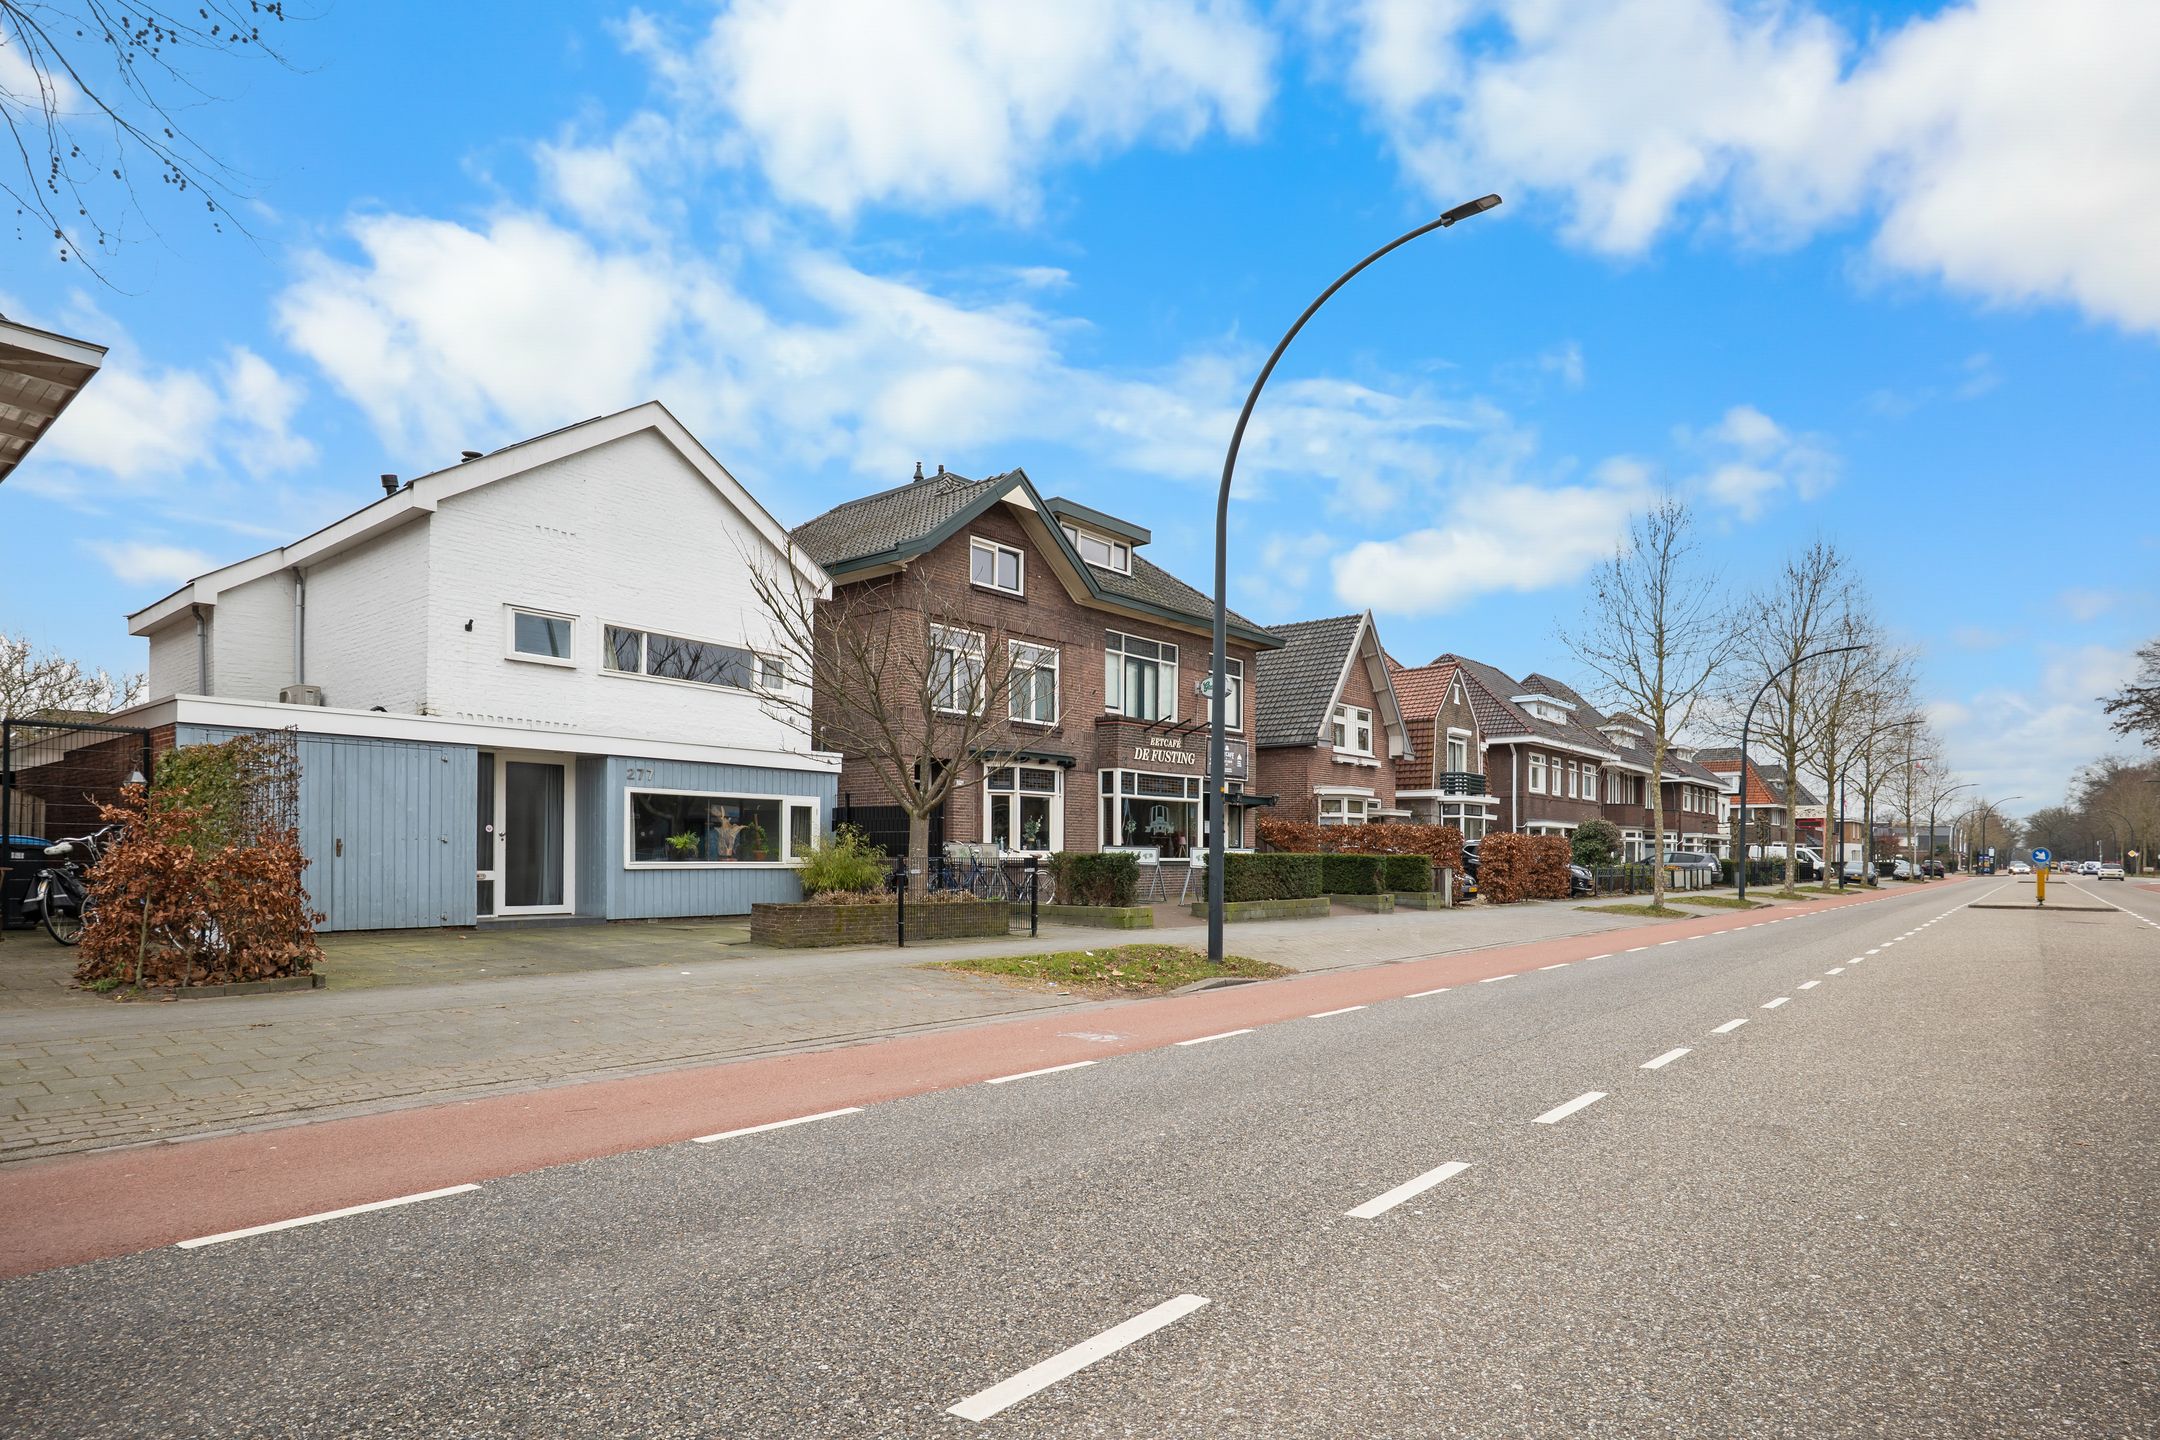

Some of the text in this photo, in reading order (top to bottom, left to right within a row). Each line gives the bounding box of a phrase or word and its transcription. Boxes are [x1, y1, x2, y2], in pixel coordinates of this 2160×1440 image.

[1134, 747, 1196, 765] DE FUSTING
[626, 768, 655, 782] 277
